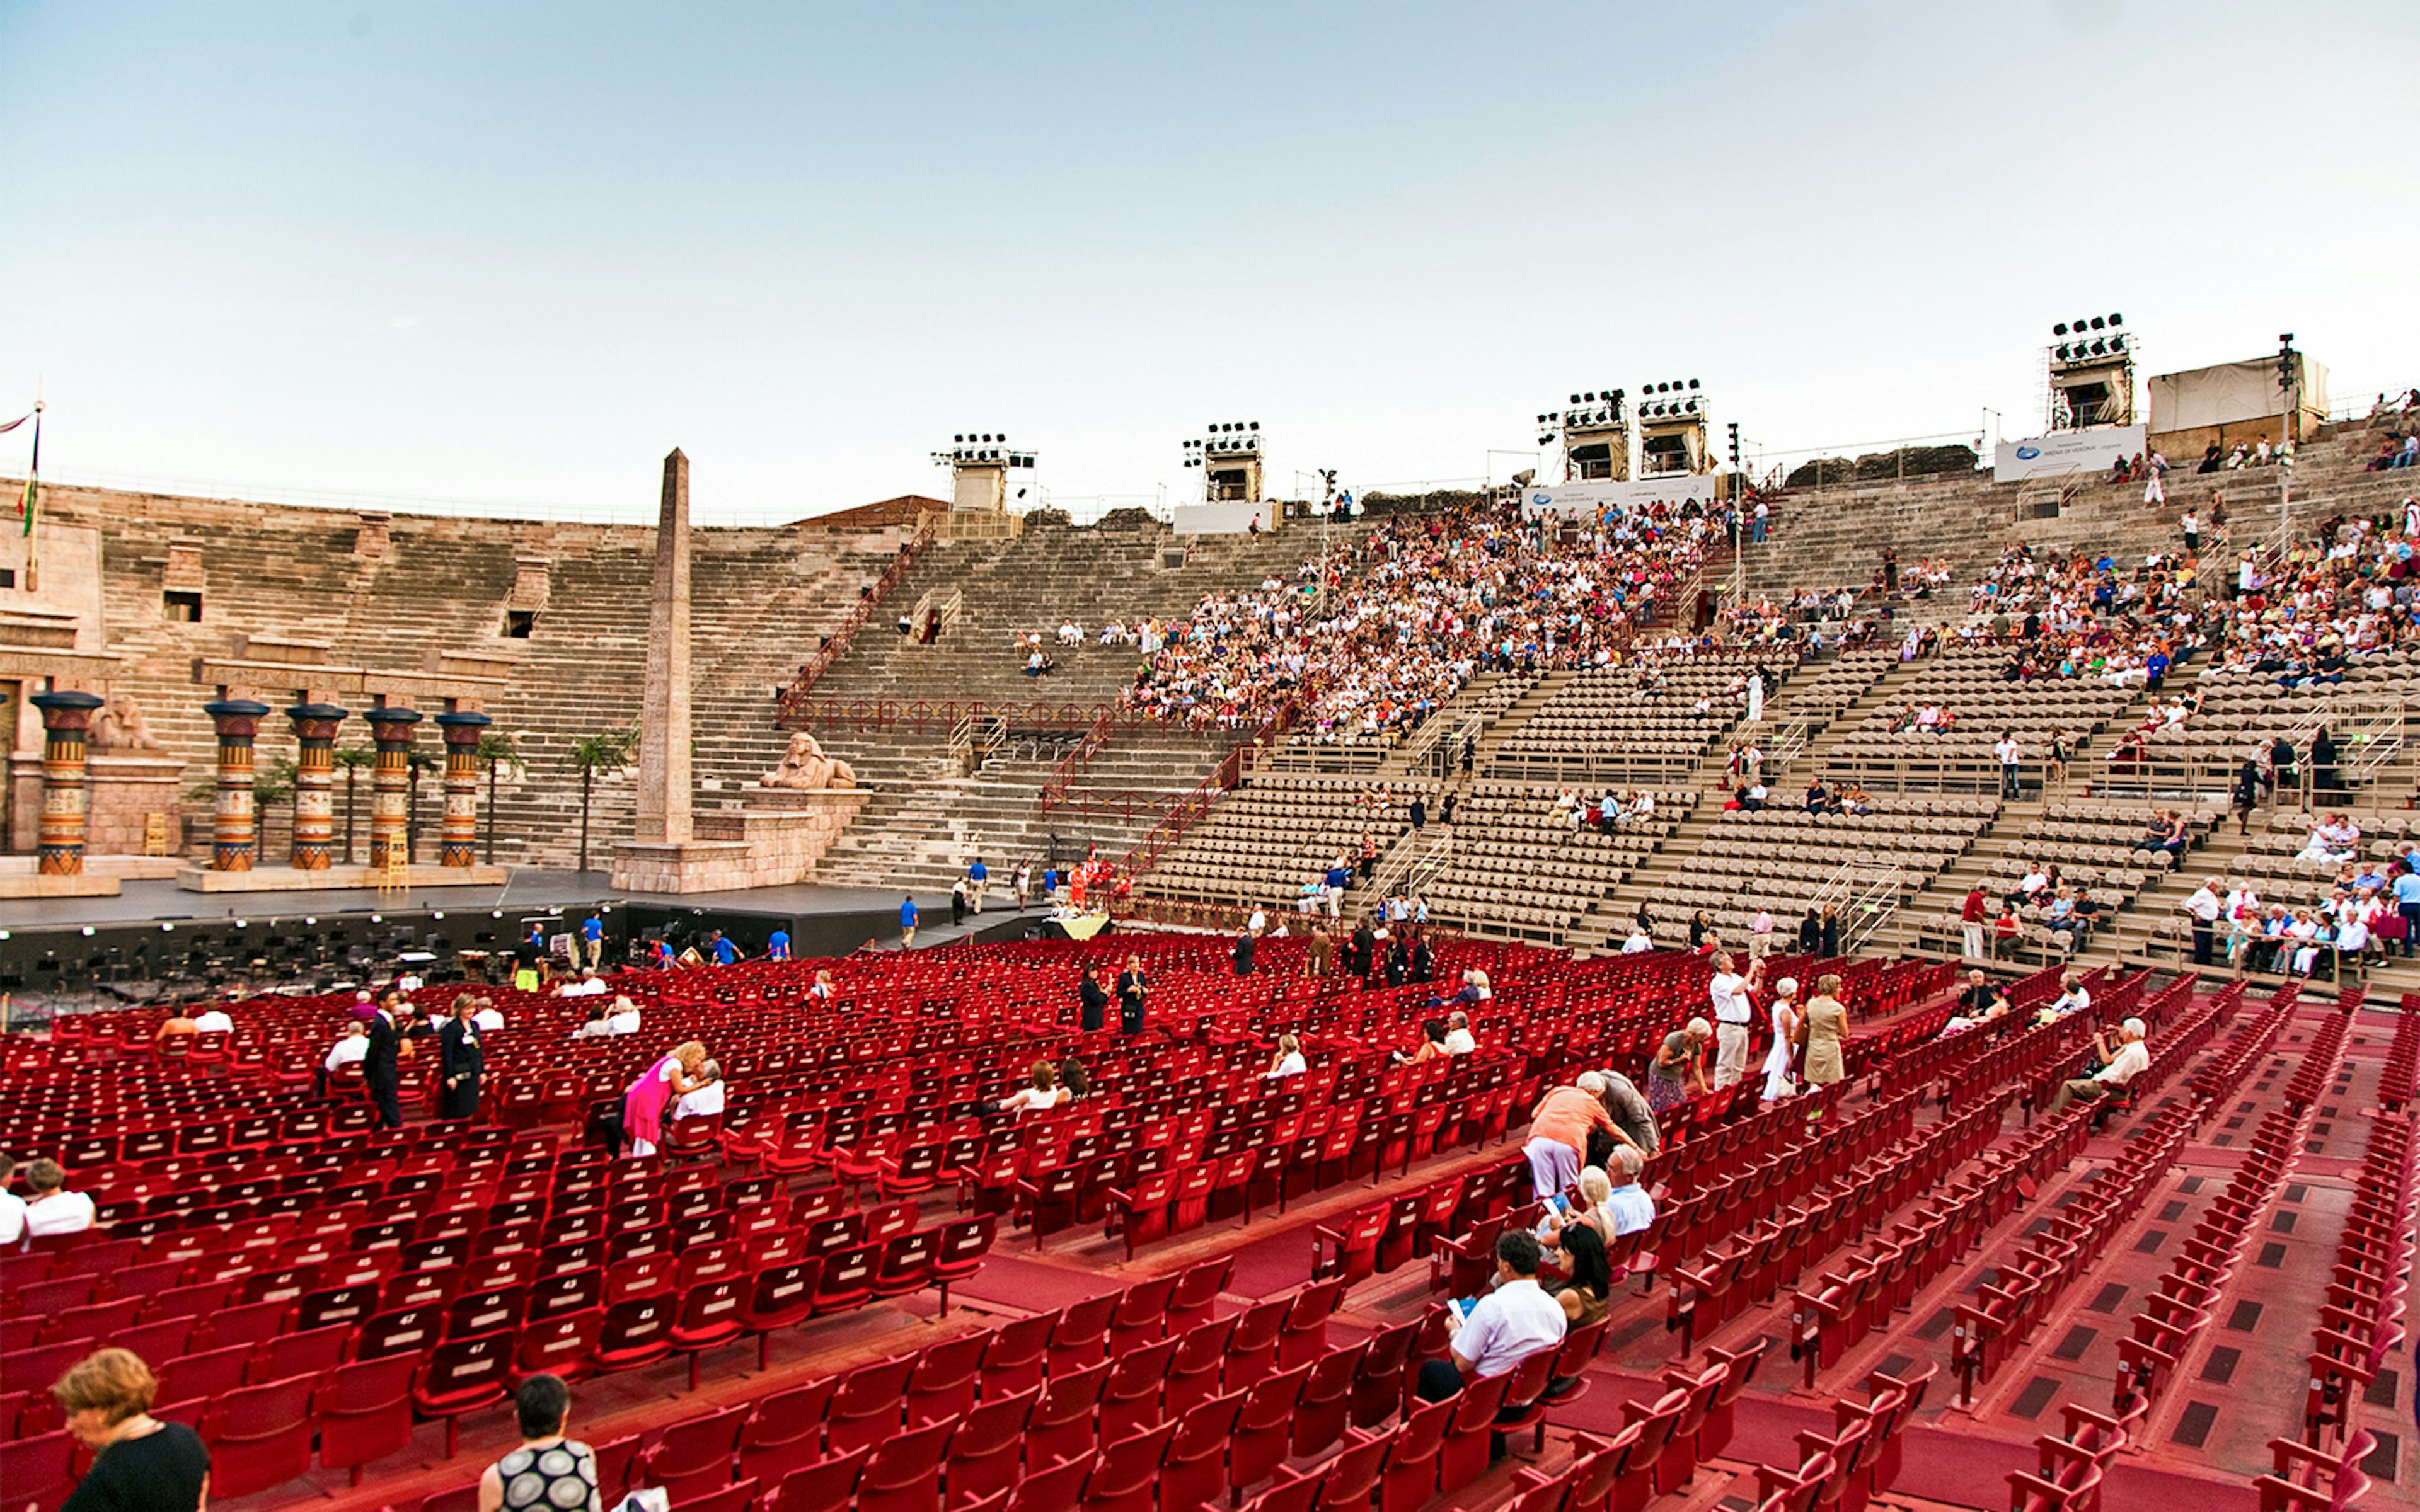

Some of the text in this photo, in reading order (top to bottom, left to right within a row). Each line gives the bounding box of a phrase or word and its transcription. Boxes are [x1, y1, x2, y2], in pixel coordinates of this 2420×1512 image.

[2072, 445, 2096, 453] VERONA
[851, 1254, 863, 1265] 37
[637, 1264, 650, 1274] 41
[715, 1286, 729, 1296] 41
[470, 1343, 485, 1354] 47
